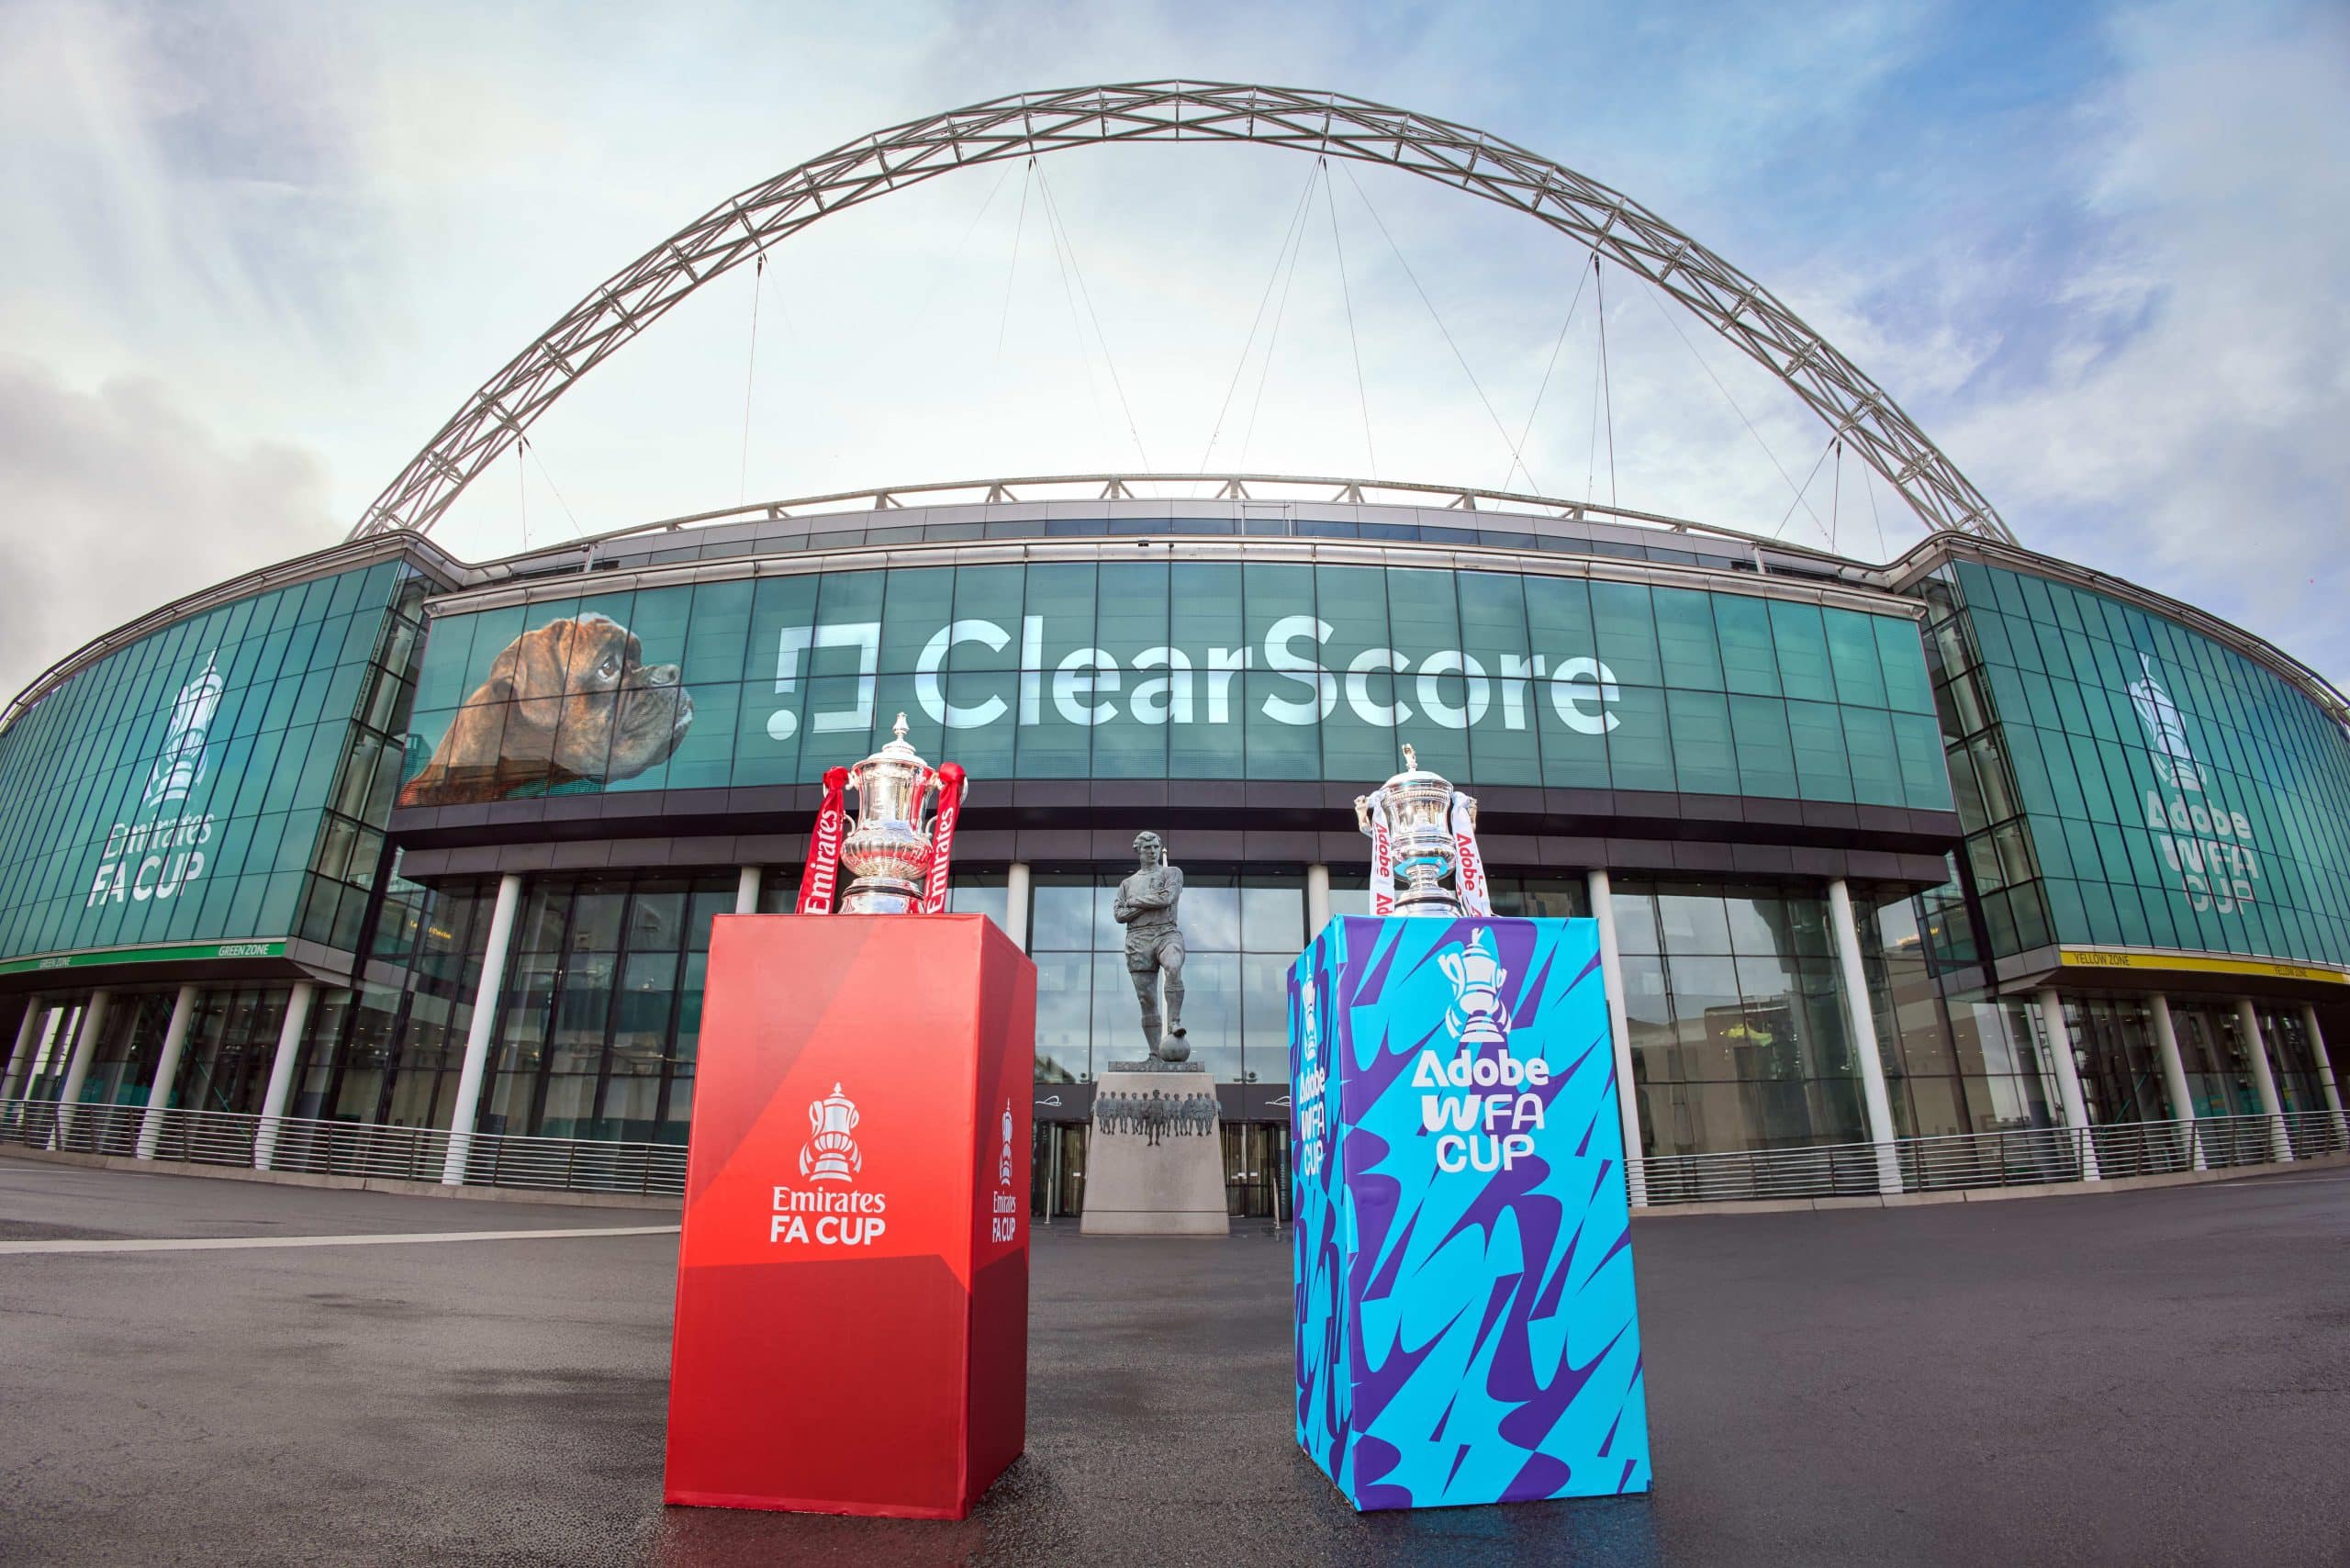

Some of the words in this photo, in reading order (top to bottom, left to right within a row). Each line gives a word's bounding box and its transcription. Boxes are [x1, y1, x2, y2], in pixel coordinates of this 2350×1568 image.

[915, 615, 1620, 734] ClearScore
[2147, 790, 2252, 839] Adobe
[103, 811, 215, 860] Emirates
[1374, 822, 1392, 879] Adobe
[804, 809, 837, 914] Emirates
[926, 807, 954, 914] Emirates
[1457, 833, 1478, 891] Adobe
[2159, 834, 2258, 879] WFA
[87, 861, 127, 907] FA
[132, 851, 205, 902] CUP
[2182, 874, 2256, 915] CUP
[218, 945, 244, 956] GREEN
[245, 944, 270, 955] ZONE
[2075, 954, 2107, 965] YELLOW
[2108, 955, 2130, 966] ZONE
[1299, 1063, 1325, 1104] Adobe
[1412, 1049, 1549, 1087] Adobe
[1301, 1102, 1325, 1142] WFA
[1422, 1093, 1545, 1132] WFA
[1304, 1140, 1323, 1176] CUP
[1436, 1134, 1535, 1173] CUP
[773, 1186, 886, 1213] Emirates
[993, 1190, 1016, 1214] Emirates
[770, 1215, 810, 1244] FA
[815, 1216, 886, 1246] CUP
[992, 1217, 1002, 1243] FA
[1002, 1217, 1016, 1242] CUP
